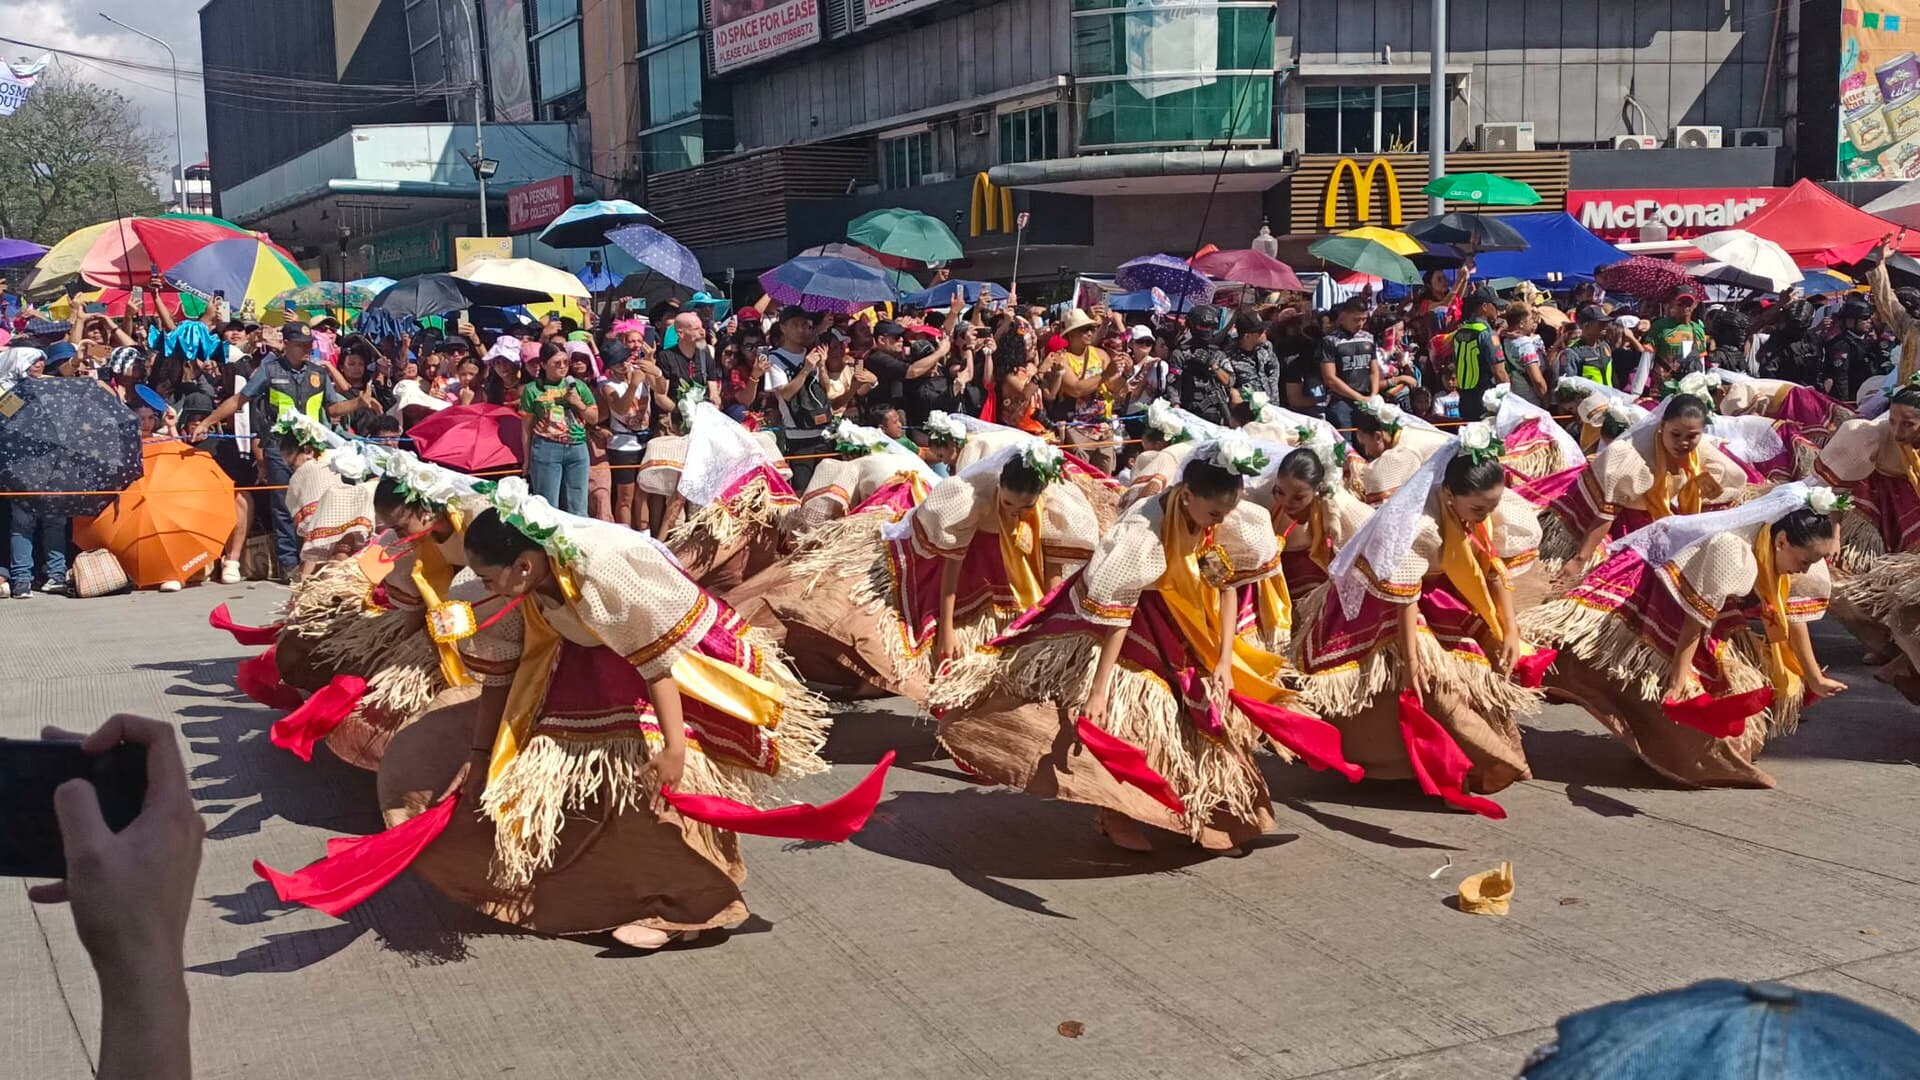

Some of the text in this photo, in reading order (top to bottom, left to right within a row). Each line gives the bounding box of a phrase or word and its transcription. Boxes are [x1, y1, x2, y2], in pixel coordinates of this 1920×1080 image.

[715, 0, 816, 49] AD SPACE FOR LEASE
[719, 46, 742, 63] PLEASE
[742, 40, 758, 56] CALL
[758, 35, 772, 50] BEA
[528, 184, 559, 205] PERSONAL
[529, 203, 560, 221] COLLECTION
